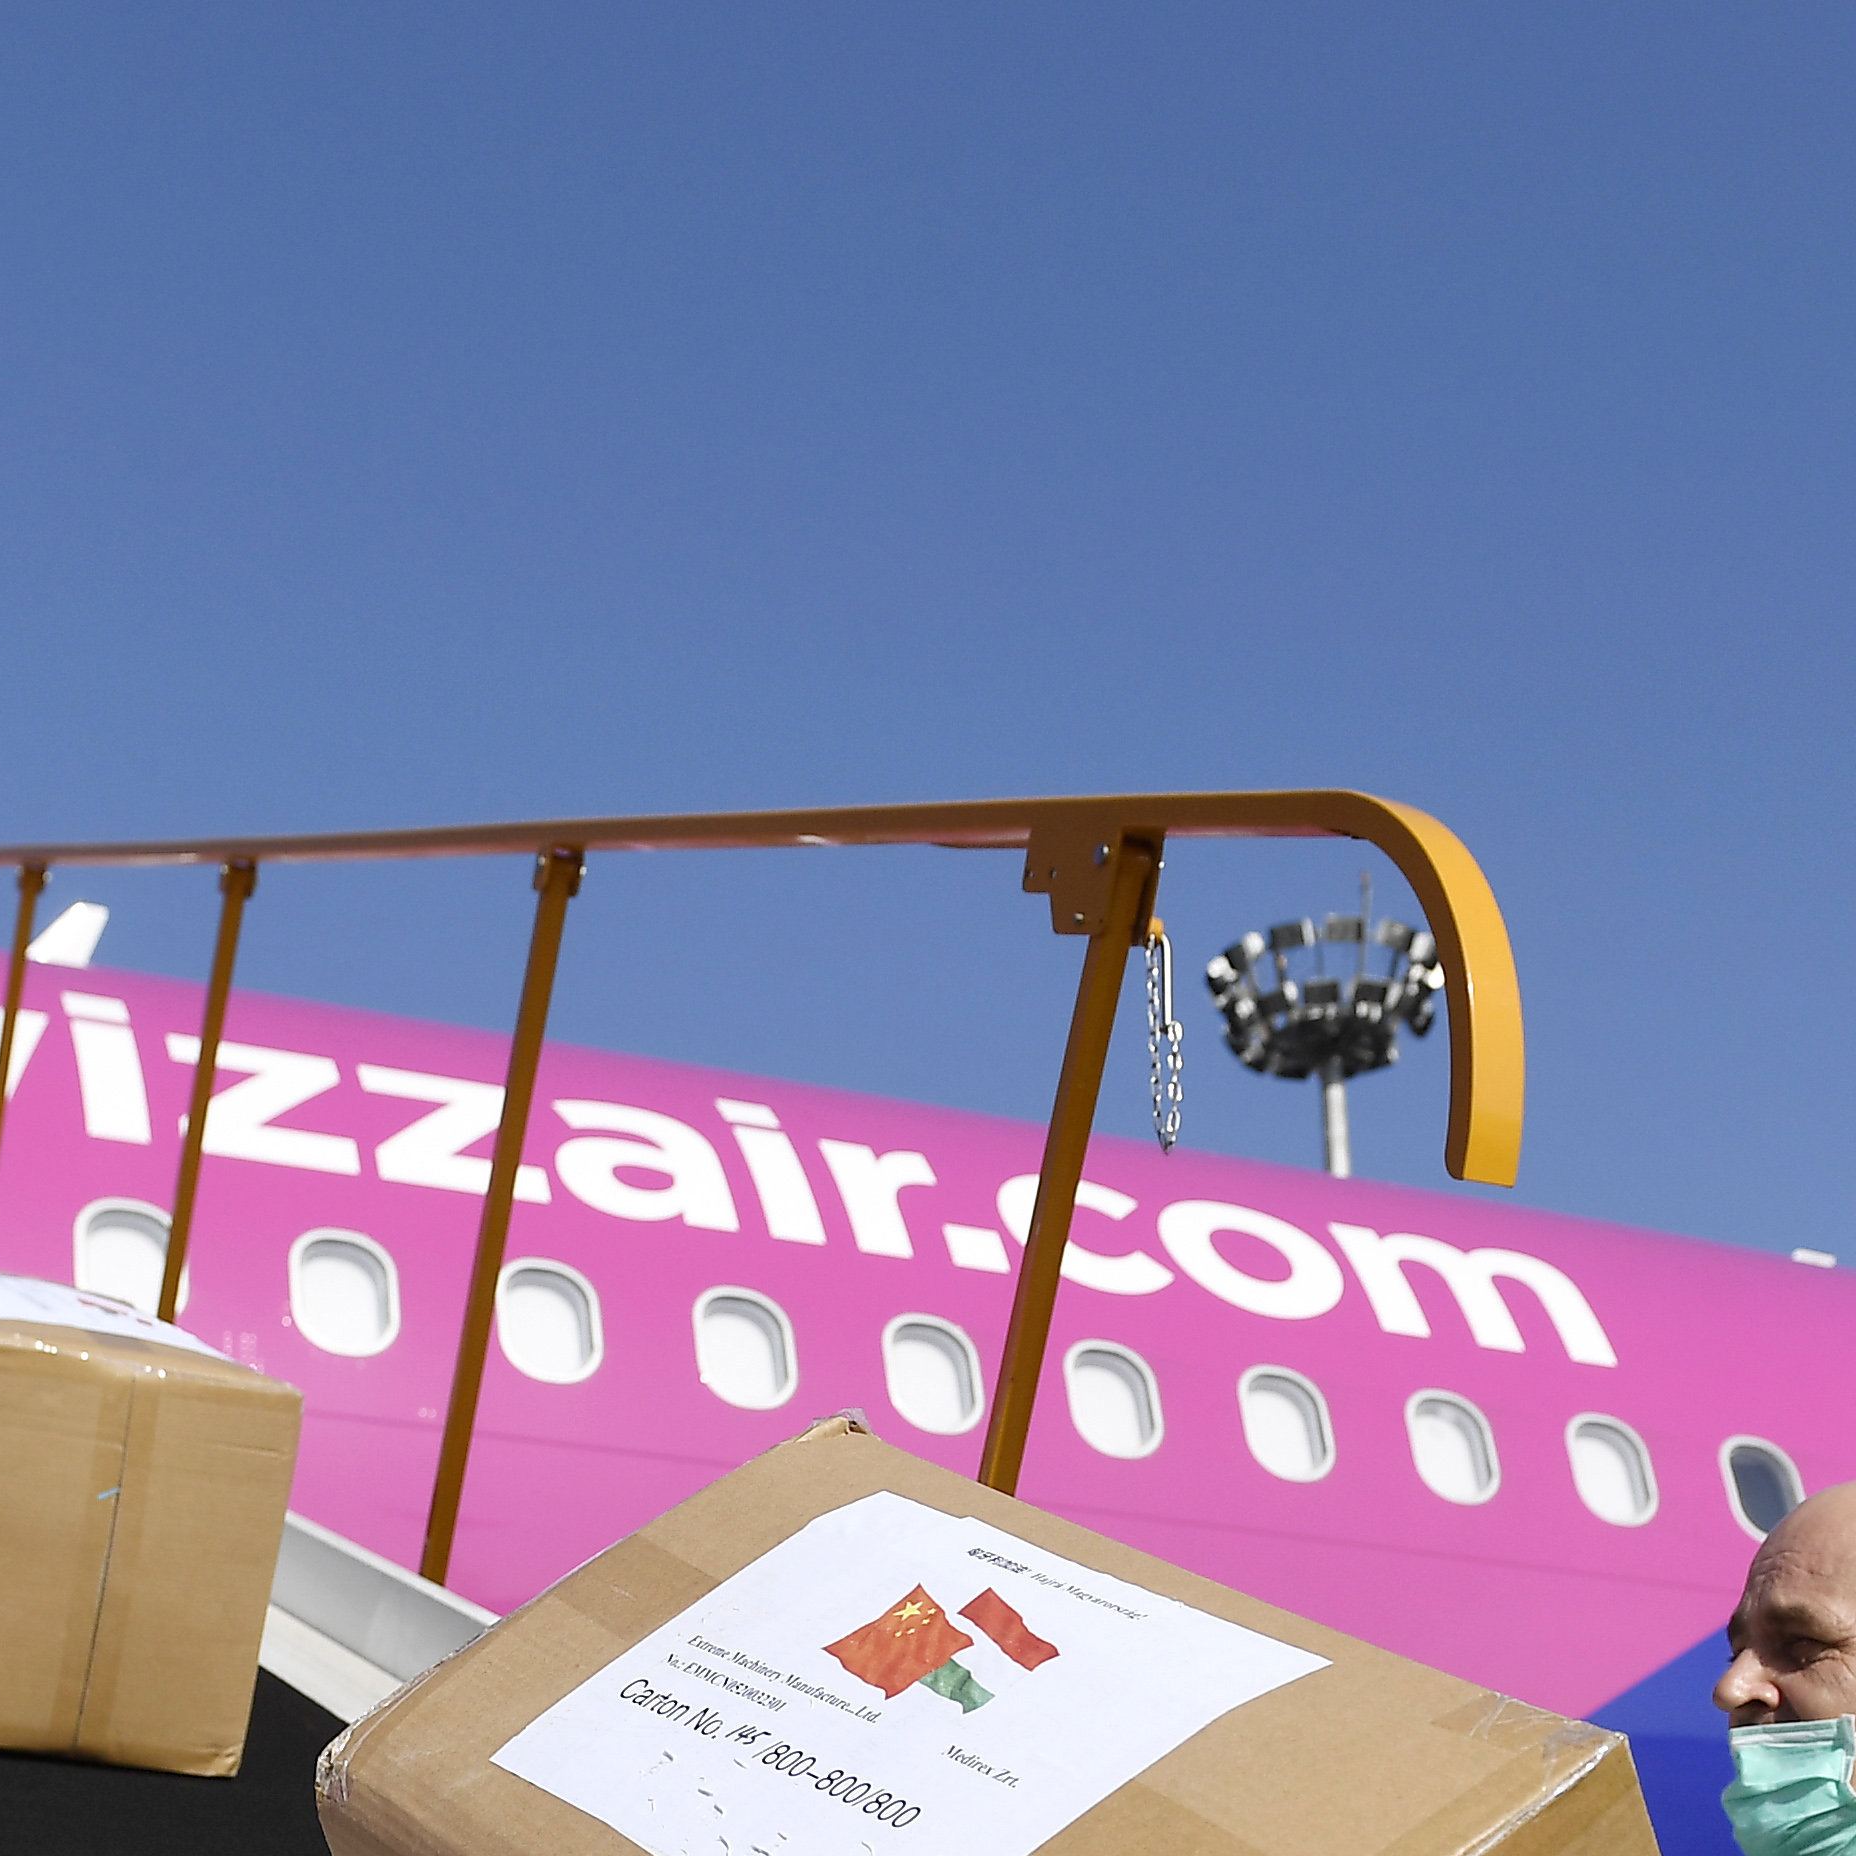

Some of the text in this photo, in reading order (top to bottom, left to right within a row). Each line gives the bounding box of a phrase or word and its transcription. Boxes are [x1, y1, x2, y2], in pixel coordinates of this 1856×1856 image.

[687, 1635, 731, 1660] Extreme
[731, 1651, 782, 1683] Machinery
[619, 1678, 691, 1727] Carton
[684, 1706, 724, 1740] No.
[941, 1744, 1021, 1789] Medirex Zrt.
